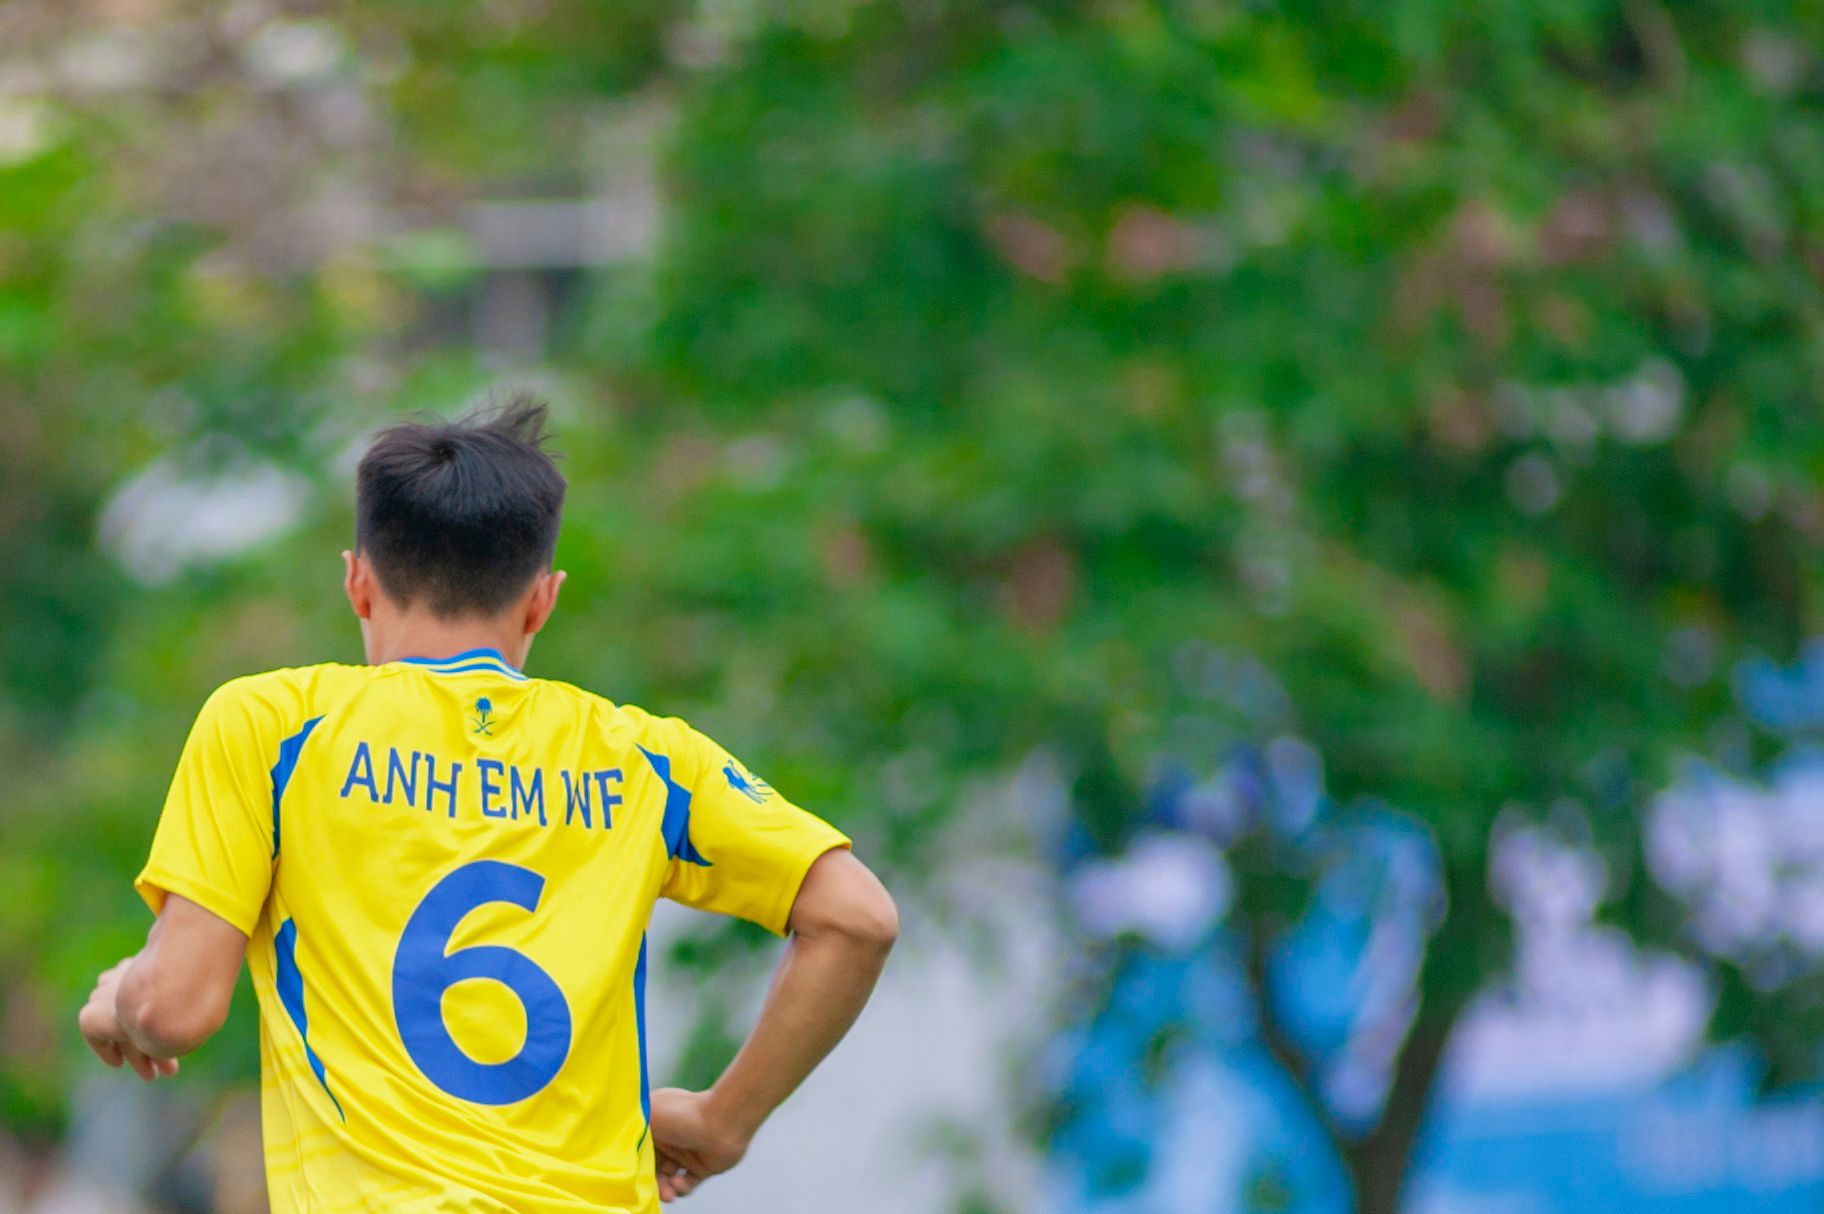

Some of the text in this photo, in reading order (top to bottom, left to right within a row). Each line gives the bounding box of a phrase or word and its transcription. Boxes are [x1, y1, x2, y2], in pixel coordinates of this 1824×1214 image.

[340, 741, 463, 818] ANH
[476, 758, 548, 827] EM
[391, 859, 573, 1107] 6
